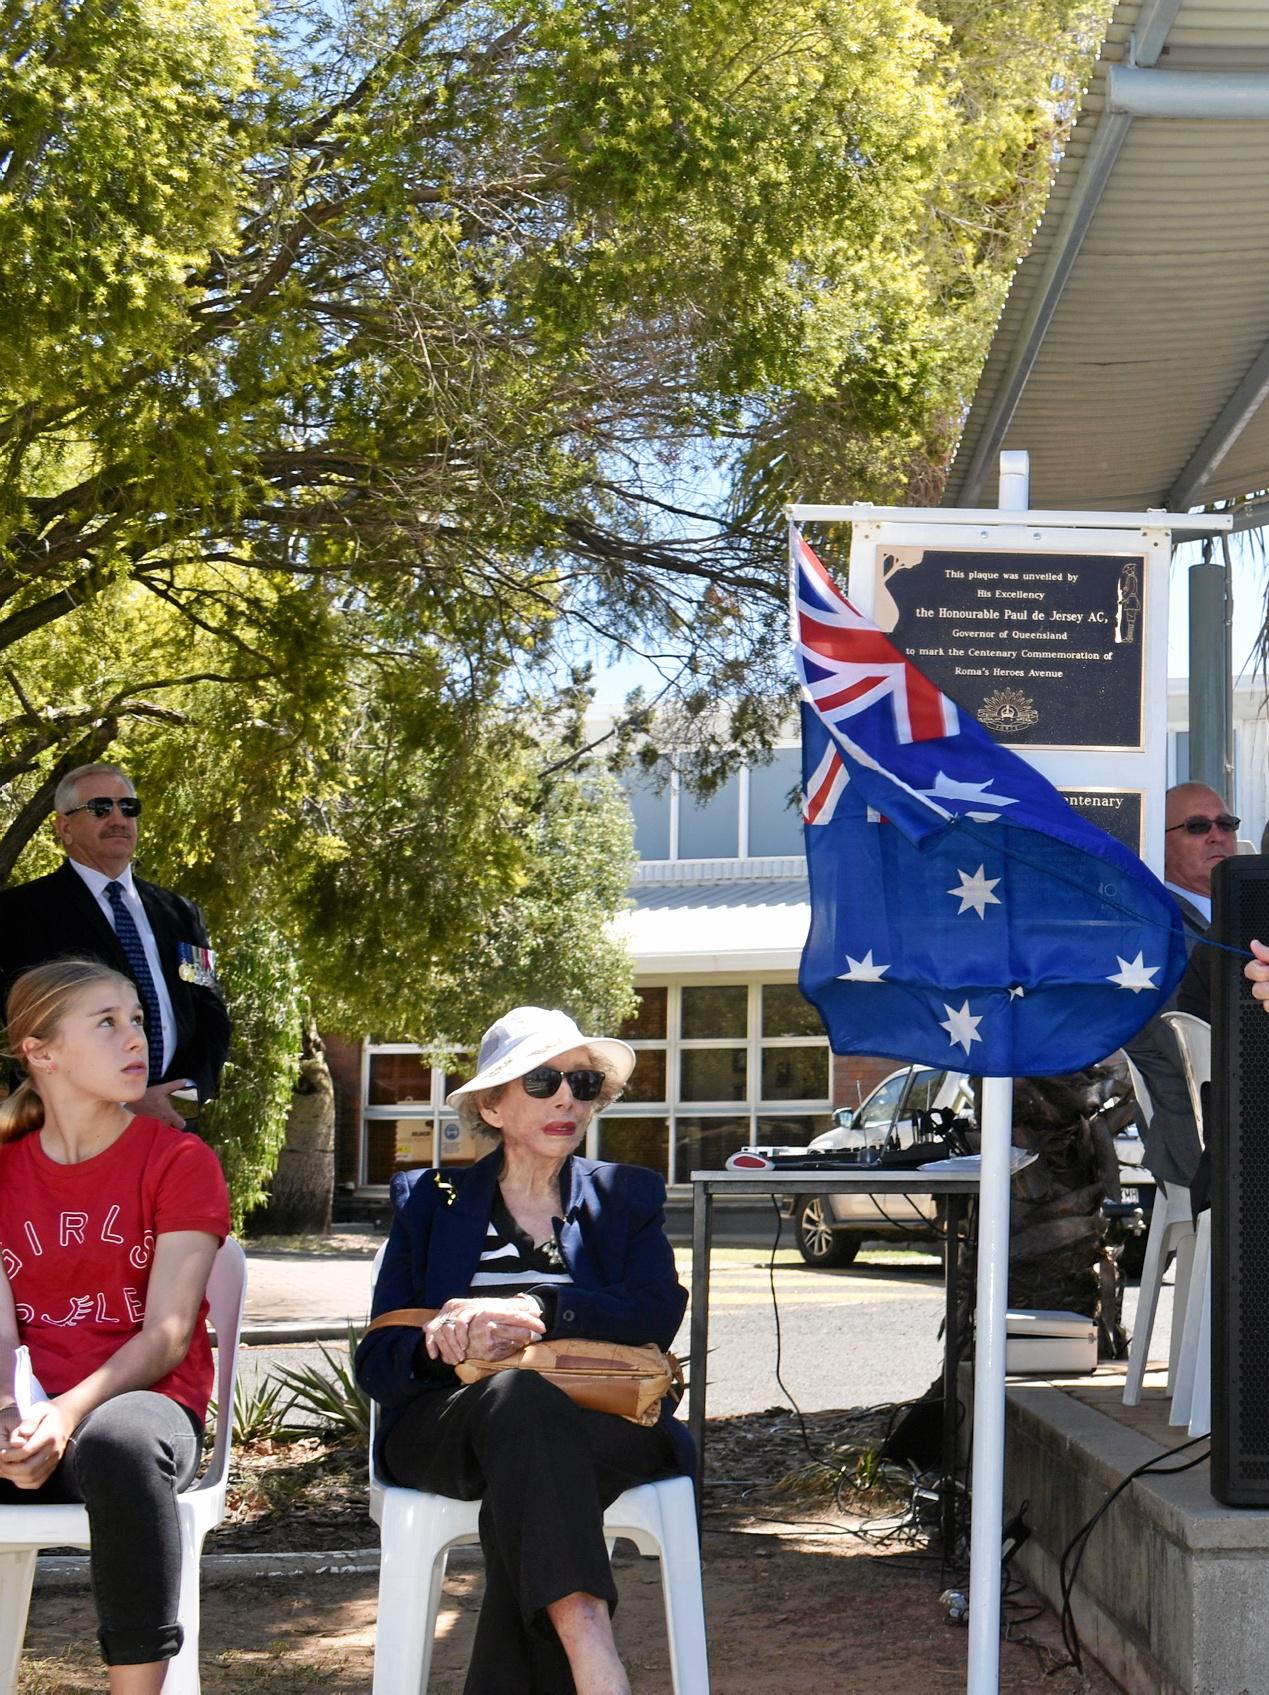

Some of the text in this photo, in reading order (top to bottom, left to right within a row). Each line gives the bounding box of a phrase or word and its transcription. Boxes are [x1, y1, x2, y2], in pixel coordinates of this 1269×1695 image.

[944, 569, 965, 578] This
[968, 570, 999, 580] plaque
[1023, 572, 1063, 581] unveiled
[1067, 573, 1079, 583] by
[977, 589, 1046, 600] His Excellency
[916, 607, 1109, 624] the Honourable Paul de Jersey AC,
[952, 628, 1068, 640] Governor of Queensland
[905, 647, 1114, 661] to mark the Centenary Commemoration of
[954, 666, 1064, 679] Roma's Heroes Avenue
